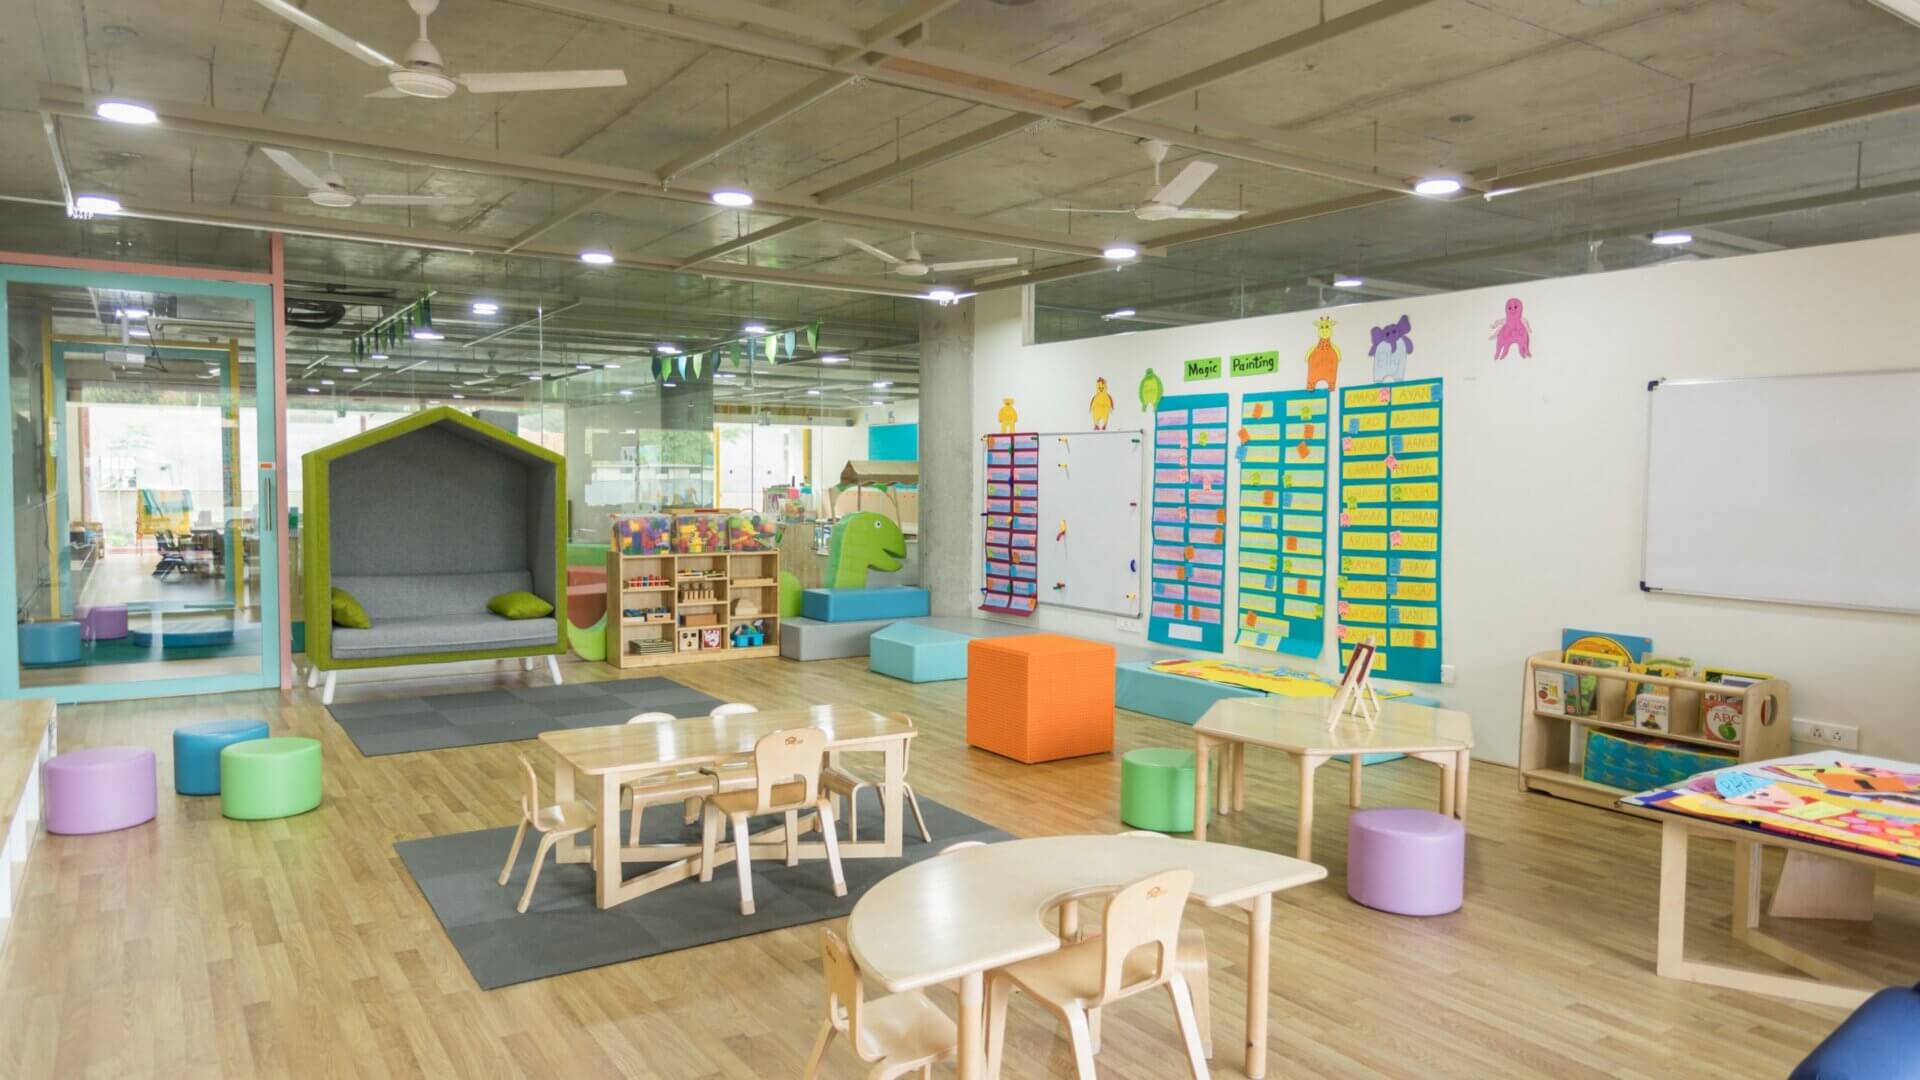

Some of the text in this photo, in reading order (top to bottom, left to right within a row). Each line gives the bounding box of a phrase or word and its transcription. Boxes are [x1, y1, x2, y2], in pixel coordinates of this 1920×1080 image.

[1188, 356, 1275, 378] Magic Painting
[1713, 711, 1741, 725] ABC
